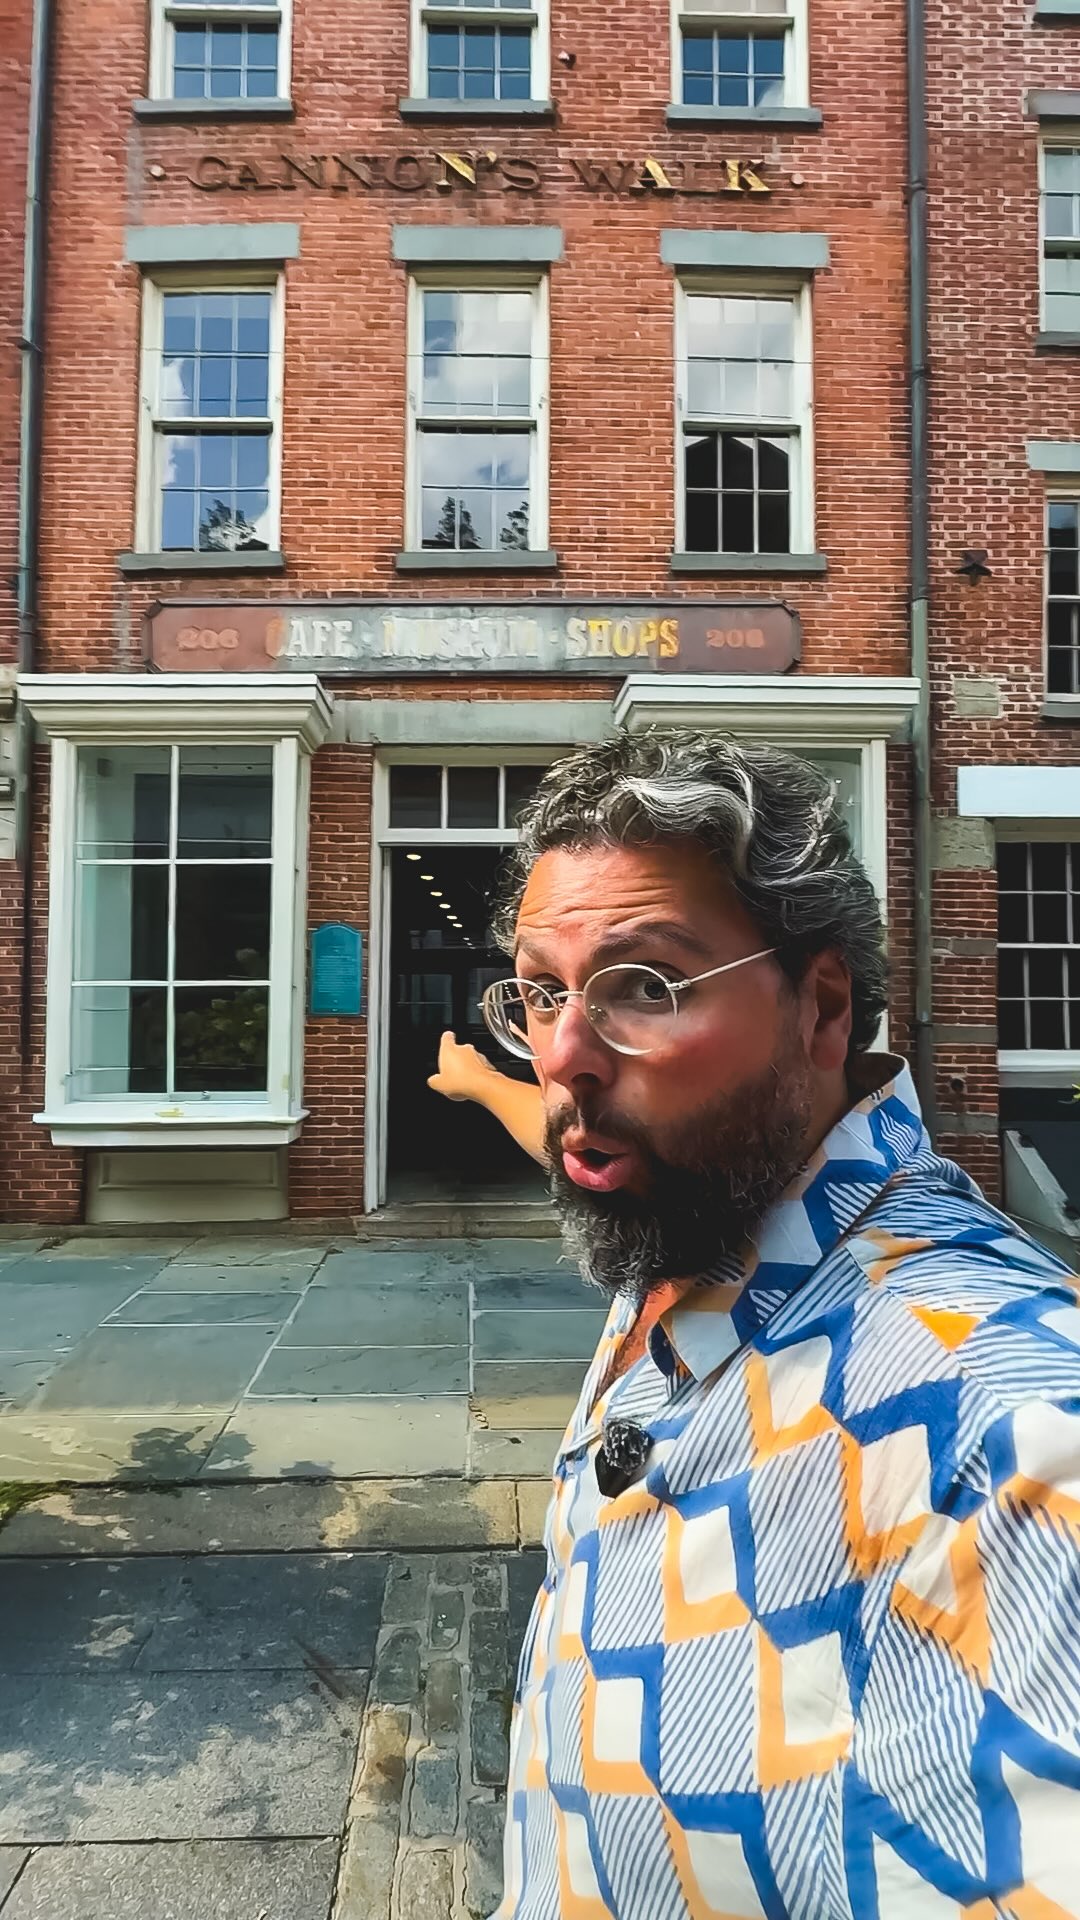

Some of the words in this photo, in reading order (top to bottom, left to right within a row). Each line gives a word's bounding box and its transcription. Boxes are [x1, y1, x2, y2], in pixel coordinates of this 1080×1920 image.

[185, 147, 542, 194] CANNON'S
[568, 156, 775, 198] WALK
[565, 616, 680, 660] SHOPS
